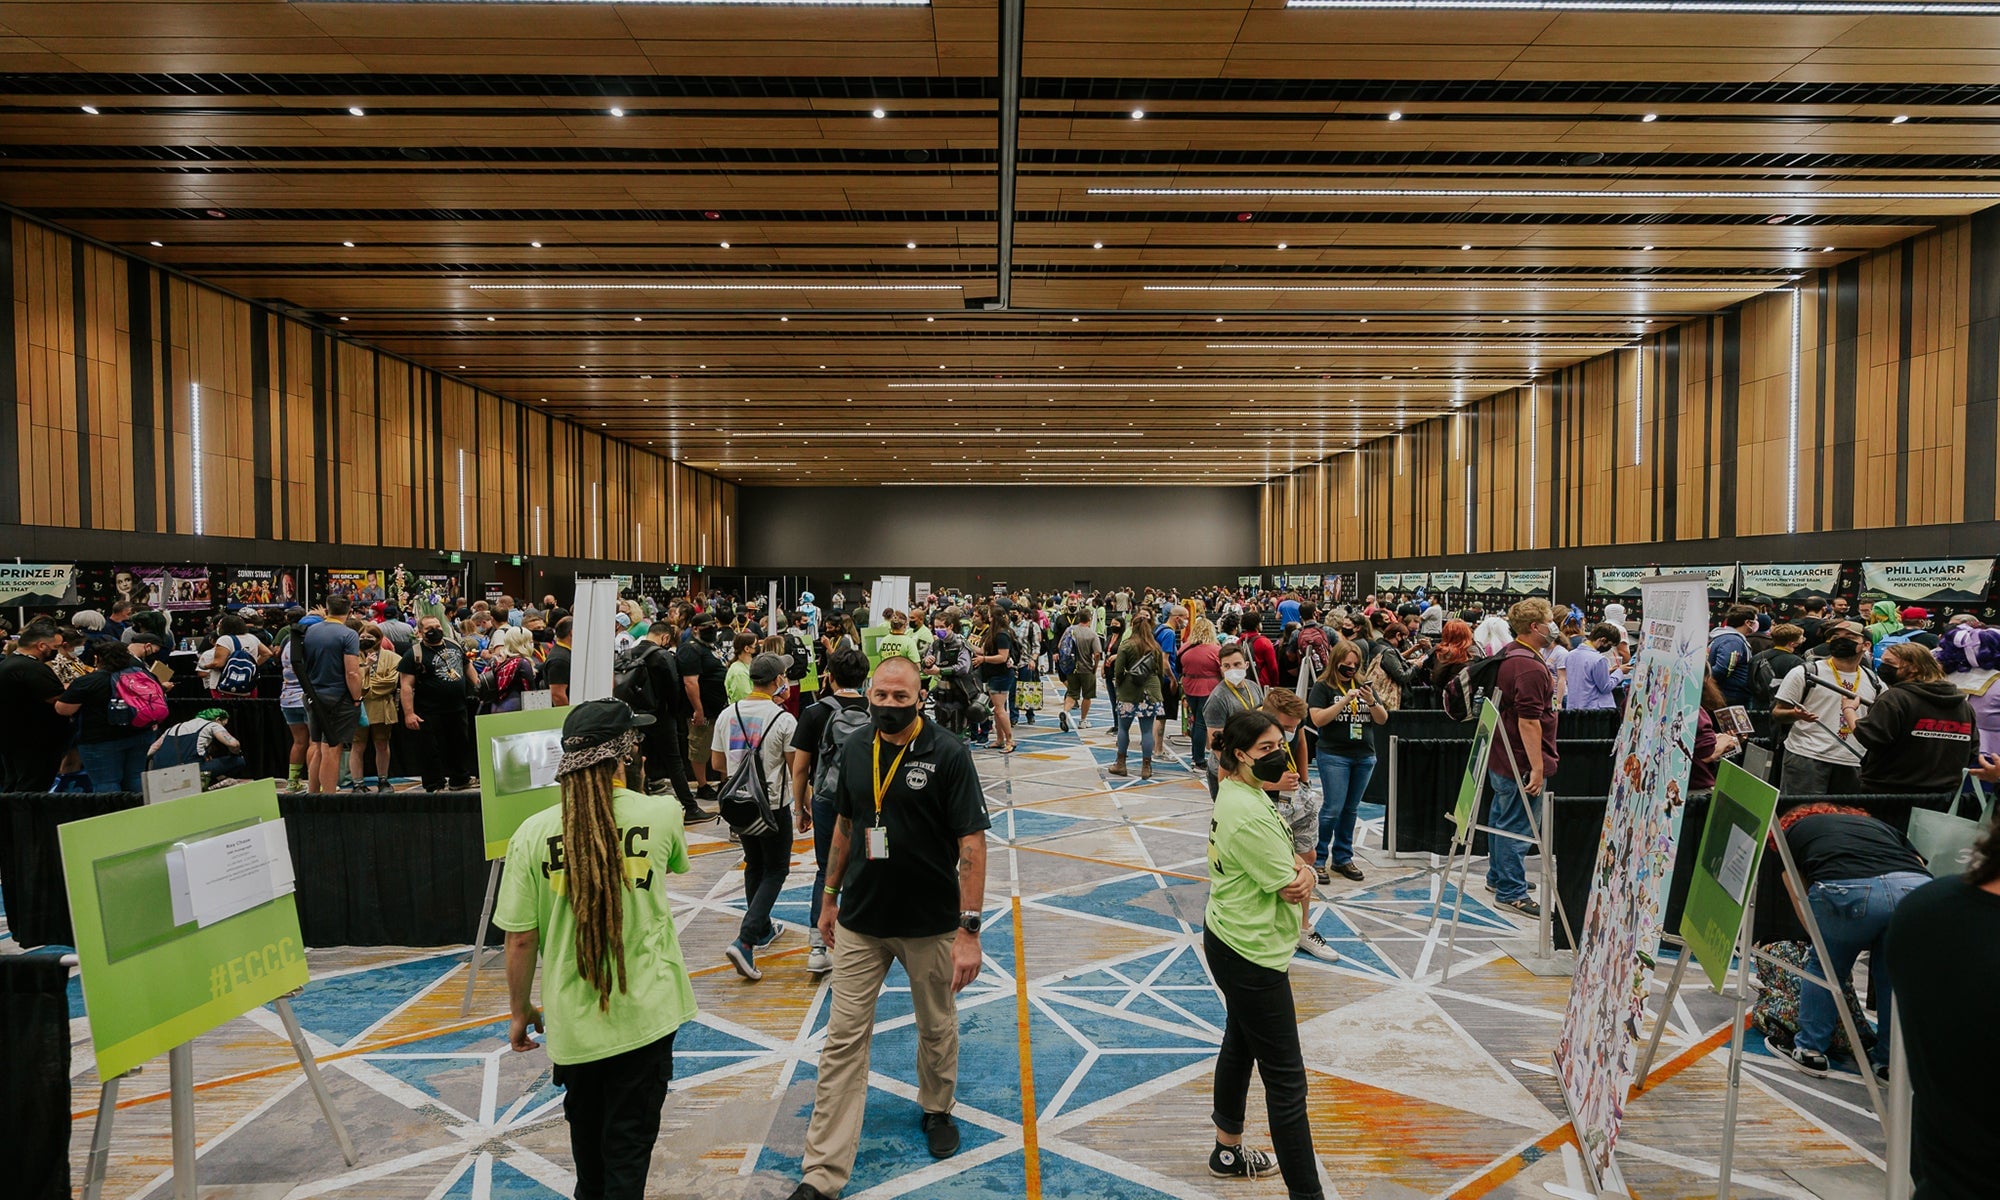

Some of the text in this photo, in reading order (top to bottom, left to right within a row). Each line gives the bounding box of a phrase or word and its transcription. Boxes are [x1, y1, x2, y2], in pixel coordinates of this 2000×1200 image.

[0, 569, 65, 578] PRINZE JR
[237, 570, 272, 578] SONNY STRAIT
[1885, 565, 1966, 575] PHIL LAMARR
[881, 643, 902, 651] ECCC
[1335, 714, 1350, 722] OT
[1914, 719, 1972, 735] RIDE
[209, 937, 297, 1000] #ECCC
